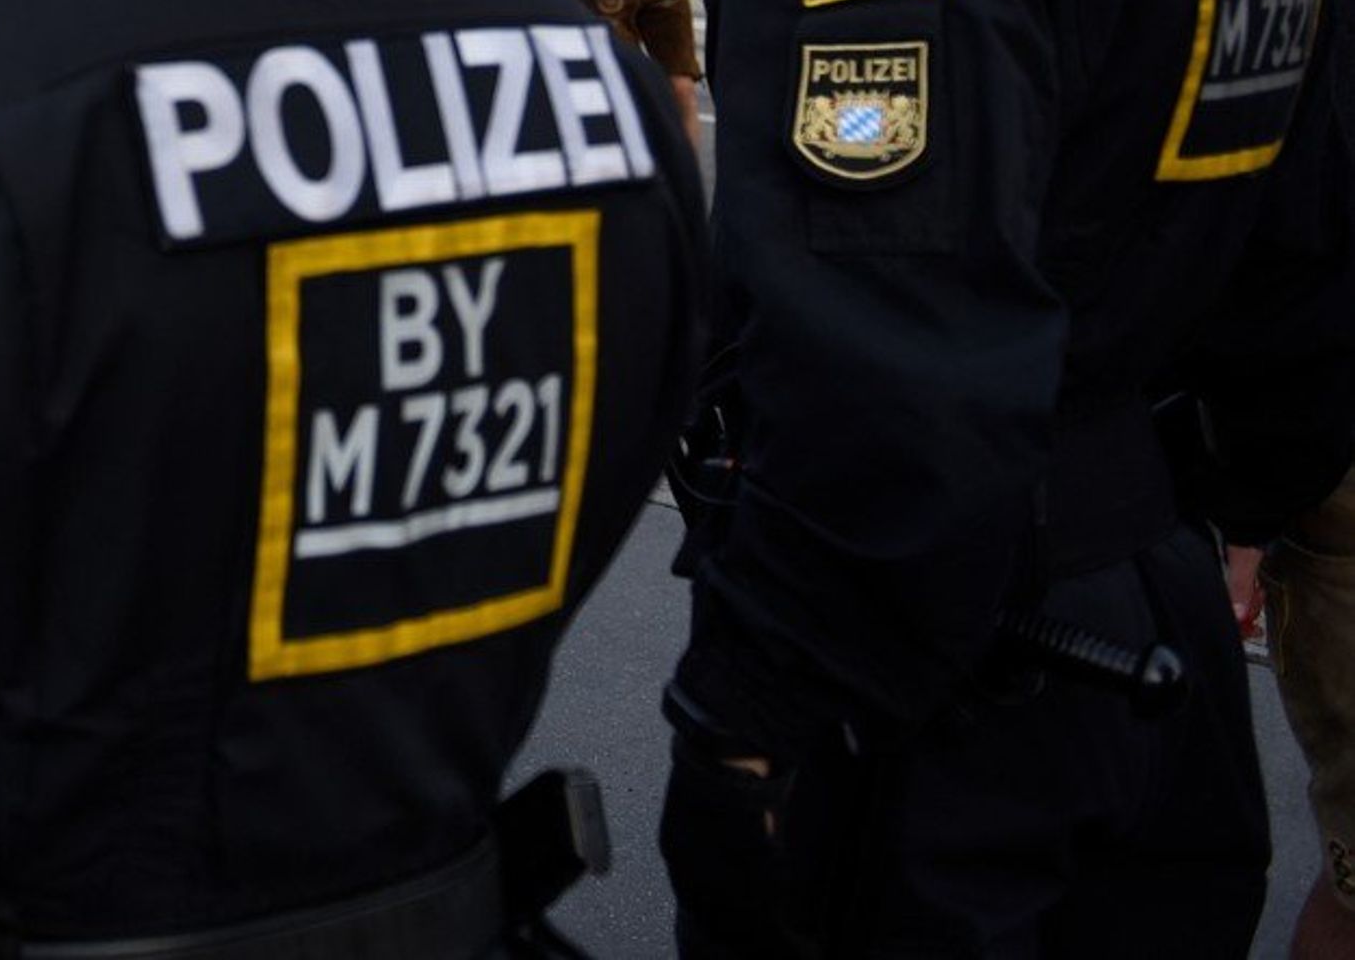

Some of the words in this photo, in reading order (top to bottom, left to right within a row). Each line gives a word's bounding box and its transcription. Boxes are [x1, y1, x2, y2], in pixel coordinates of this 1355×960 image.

[135, 24, 655, 239] POLIZEI
[812, 57, 917, 83] POLIZEI
[379, 258, 505, 391] BY
[306, 406, 379, 524] M
[400, 374, 562, 510] 7321
